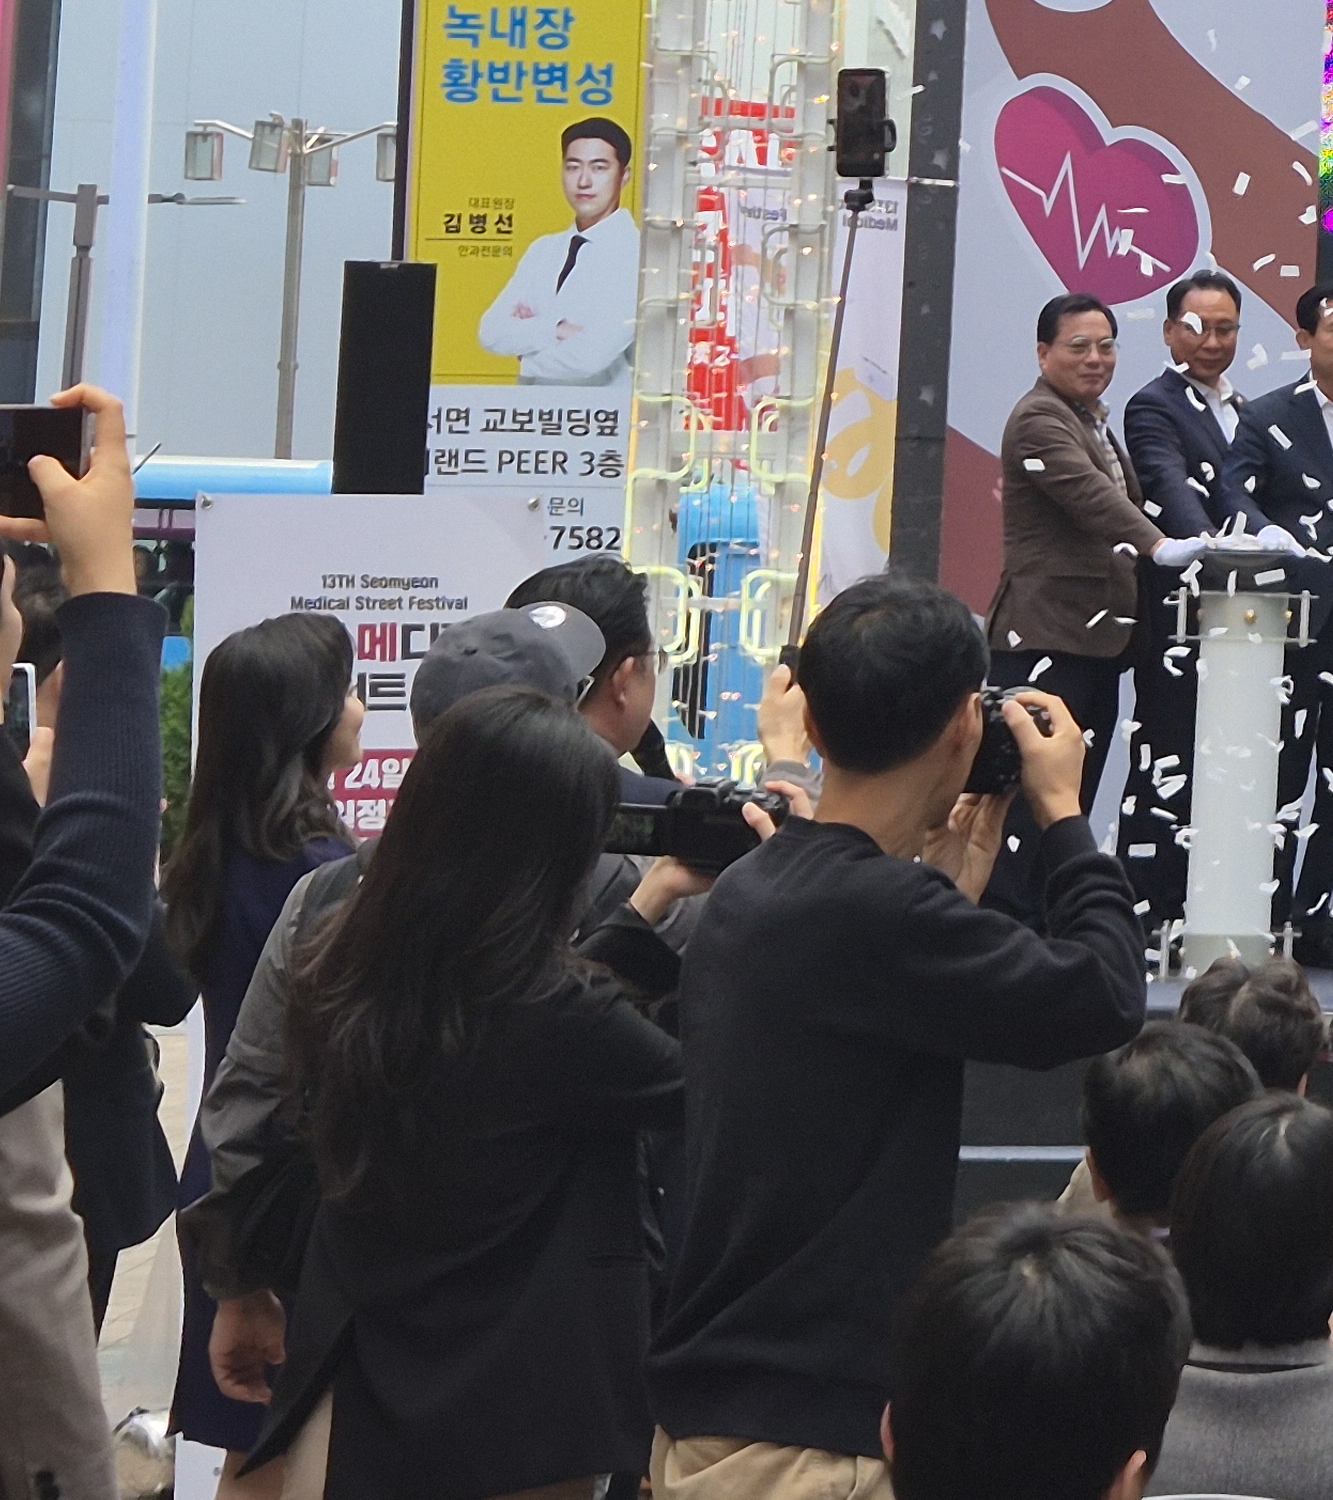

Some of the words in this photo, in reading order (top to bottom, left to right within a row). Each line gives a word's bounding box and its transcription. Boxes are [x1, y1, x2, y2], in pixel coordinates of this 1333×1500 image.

[443, 4, 576, 51] 녹내장
[440, 58, 615, 107] 황반변성
[468, 197, 515, 209] 대표원장
[457, 244, 513, 258] 안과전문의
[479, 407, 619, 437] 교보빌딩옆
[426, 448, 489, 476] 랜드
[498, 450, 568, 476] PEER
[579, 450, 625, 479] 3층
[548, 496, 585, 517] 문의
[548, 525, 622, 552] 7582
[321, 574, 355, 590] 13TH
[360, 574, 439, 593] Seomyeon
[290, 596, 350, 612] Medical
[354, 596, 405, 611] Street
[408, 595, 469, 612] Festival
